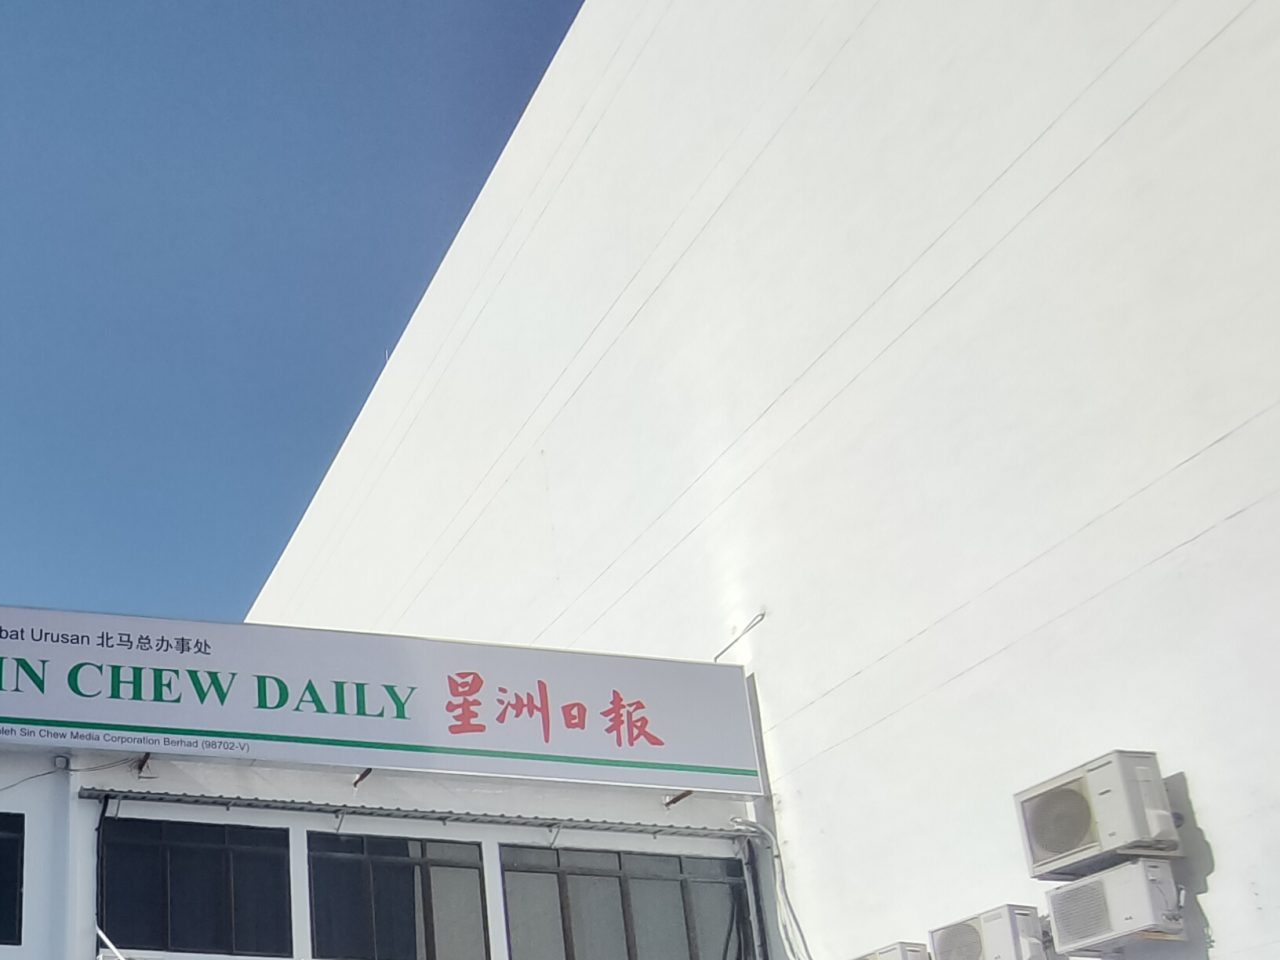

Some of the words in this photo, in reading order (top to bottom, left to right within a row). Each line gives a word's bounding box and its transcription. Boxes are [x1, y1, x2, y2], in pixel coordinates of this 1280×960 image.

[30, 628, 90, 646] Urusan
[96, 631, 212, 656] 北马总办事处
[66, 661, 236, 708] CHEW
[253, 674, 418, 721] DAILY
[19, 727, 36, 738] Sin
[38, 729, 68, 740] Chew
[70, 731, 100, 742] Media
[102, 732, 161, 746] Corporation
[163, 737, 199, 749] Berhad
[200, 739, 251, 753] (98702-V)
